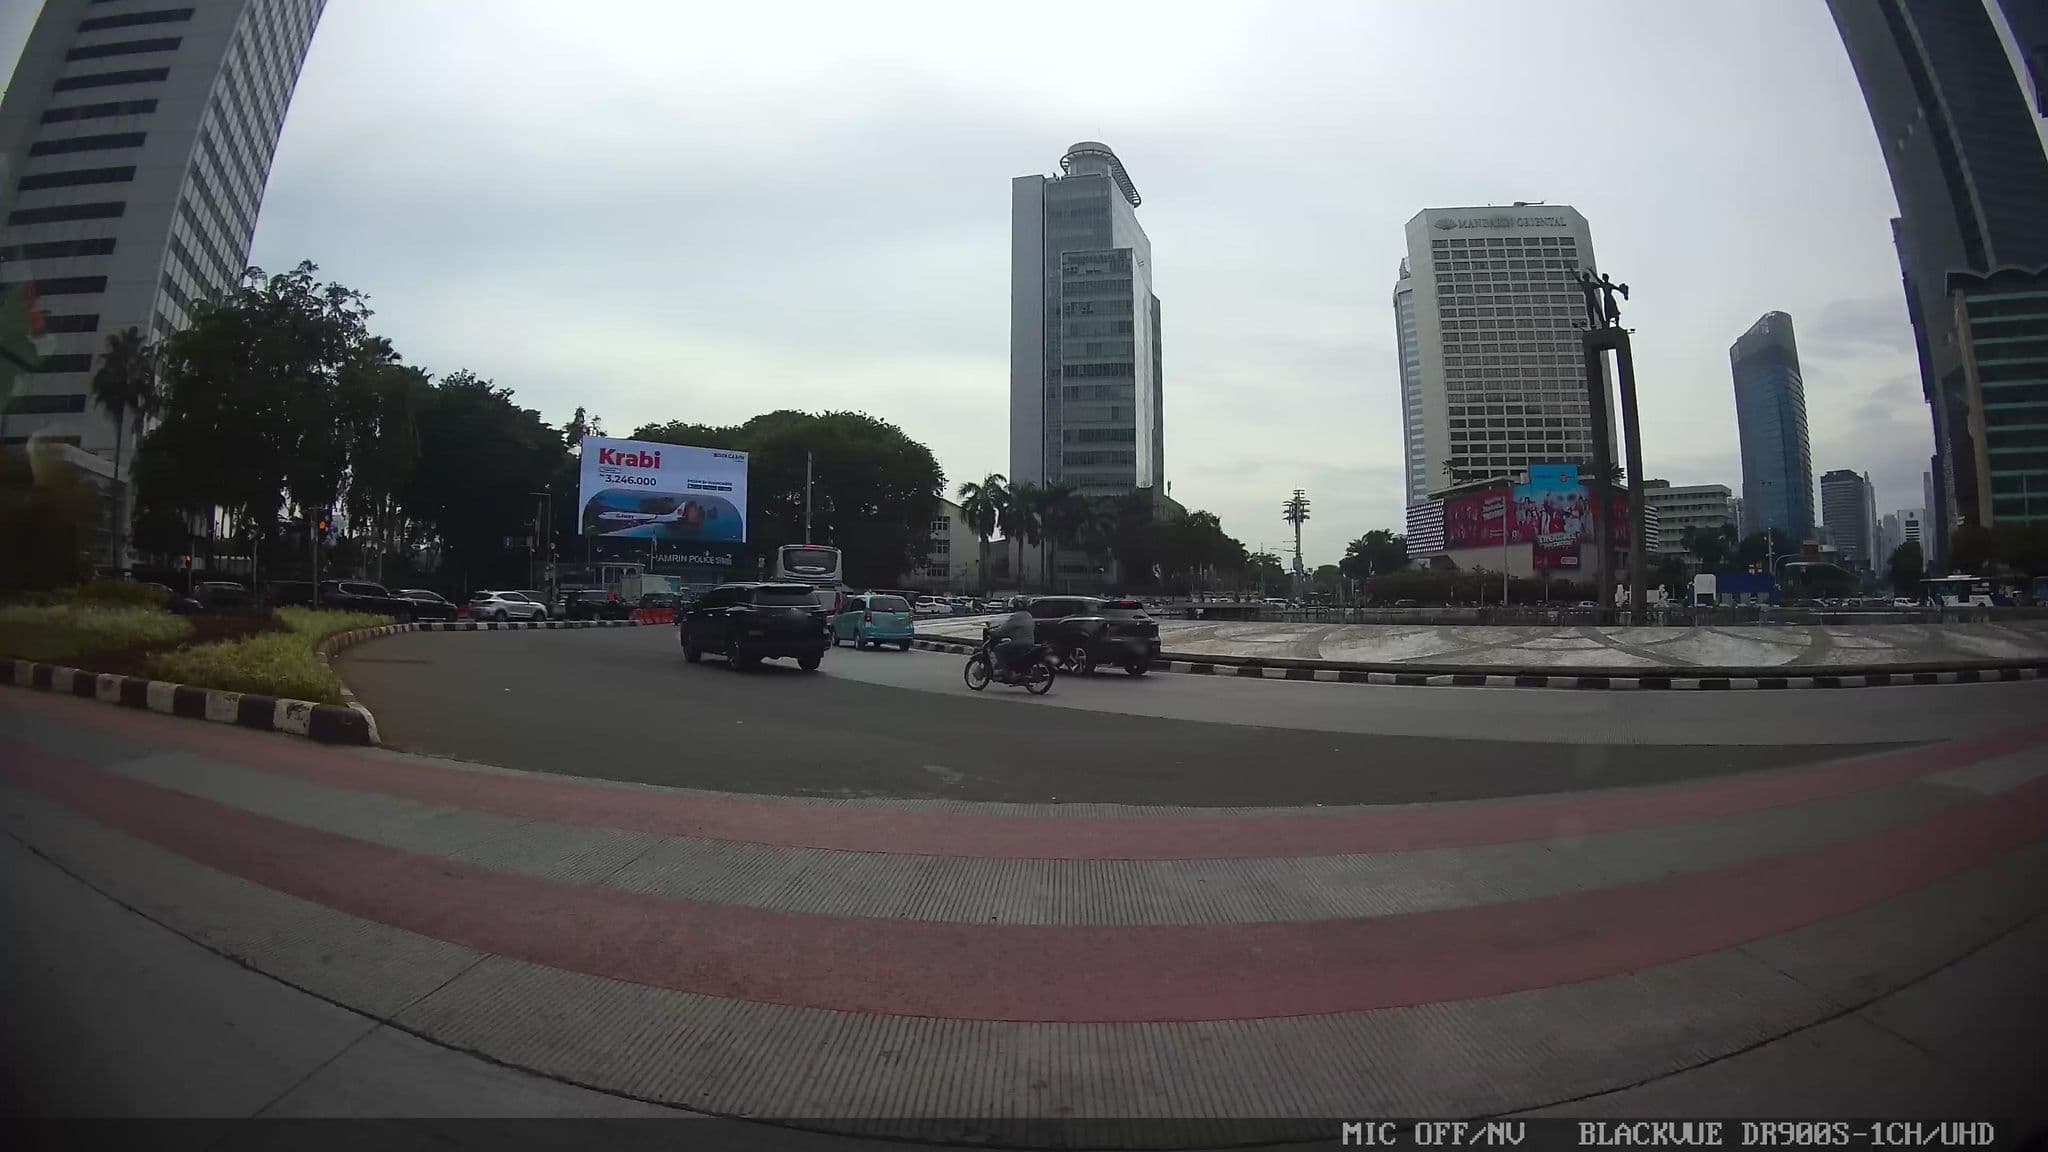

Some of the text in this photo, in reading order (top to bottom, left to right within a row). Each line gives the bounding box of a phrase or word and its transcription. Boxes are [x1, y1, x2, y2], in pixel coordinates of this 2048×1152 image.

[1516, 216, 1568, 227] ORIENTAL
[599, 448, 662, 469] Krabi
[605, 474, 657, 486] 3.246.000
[689, 555, 715, 564] POLICE
